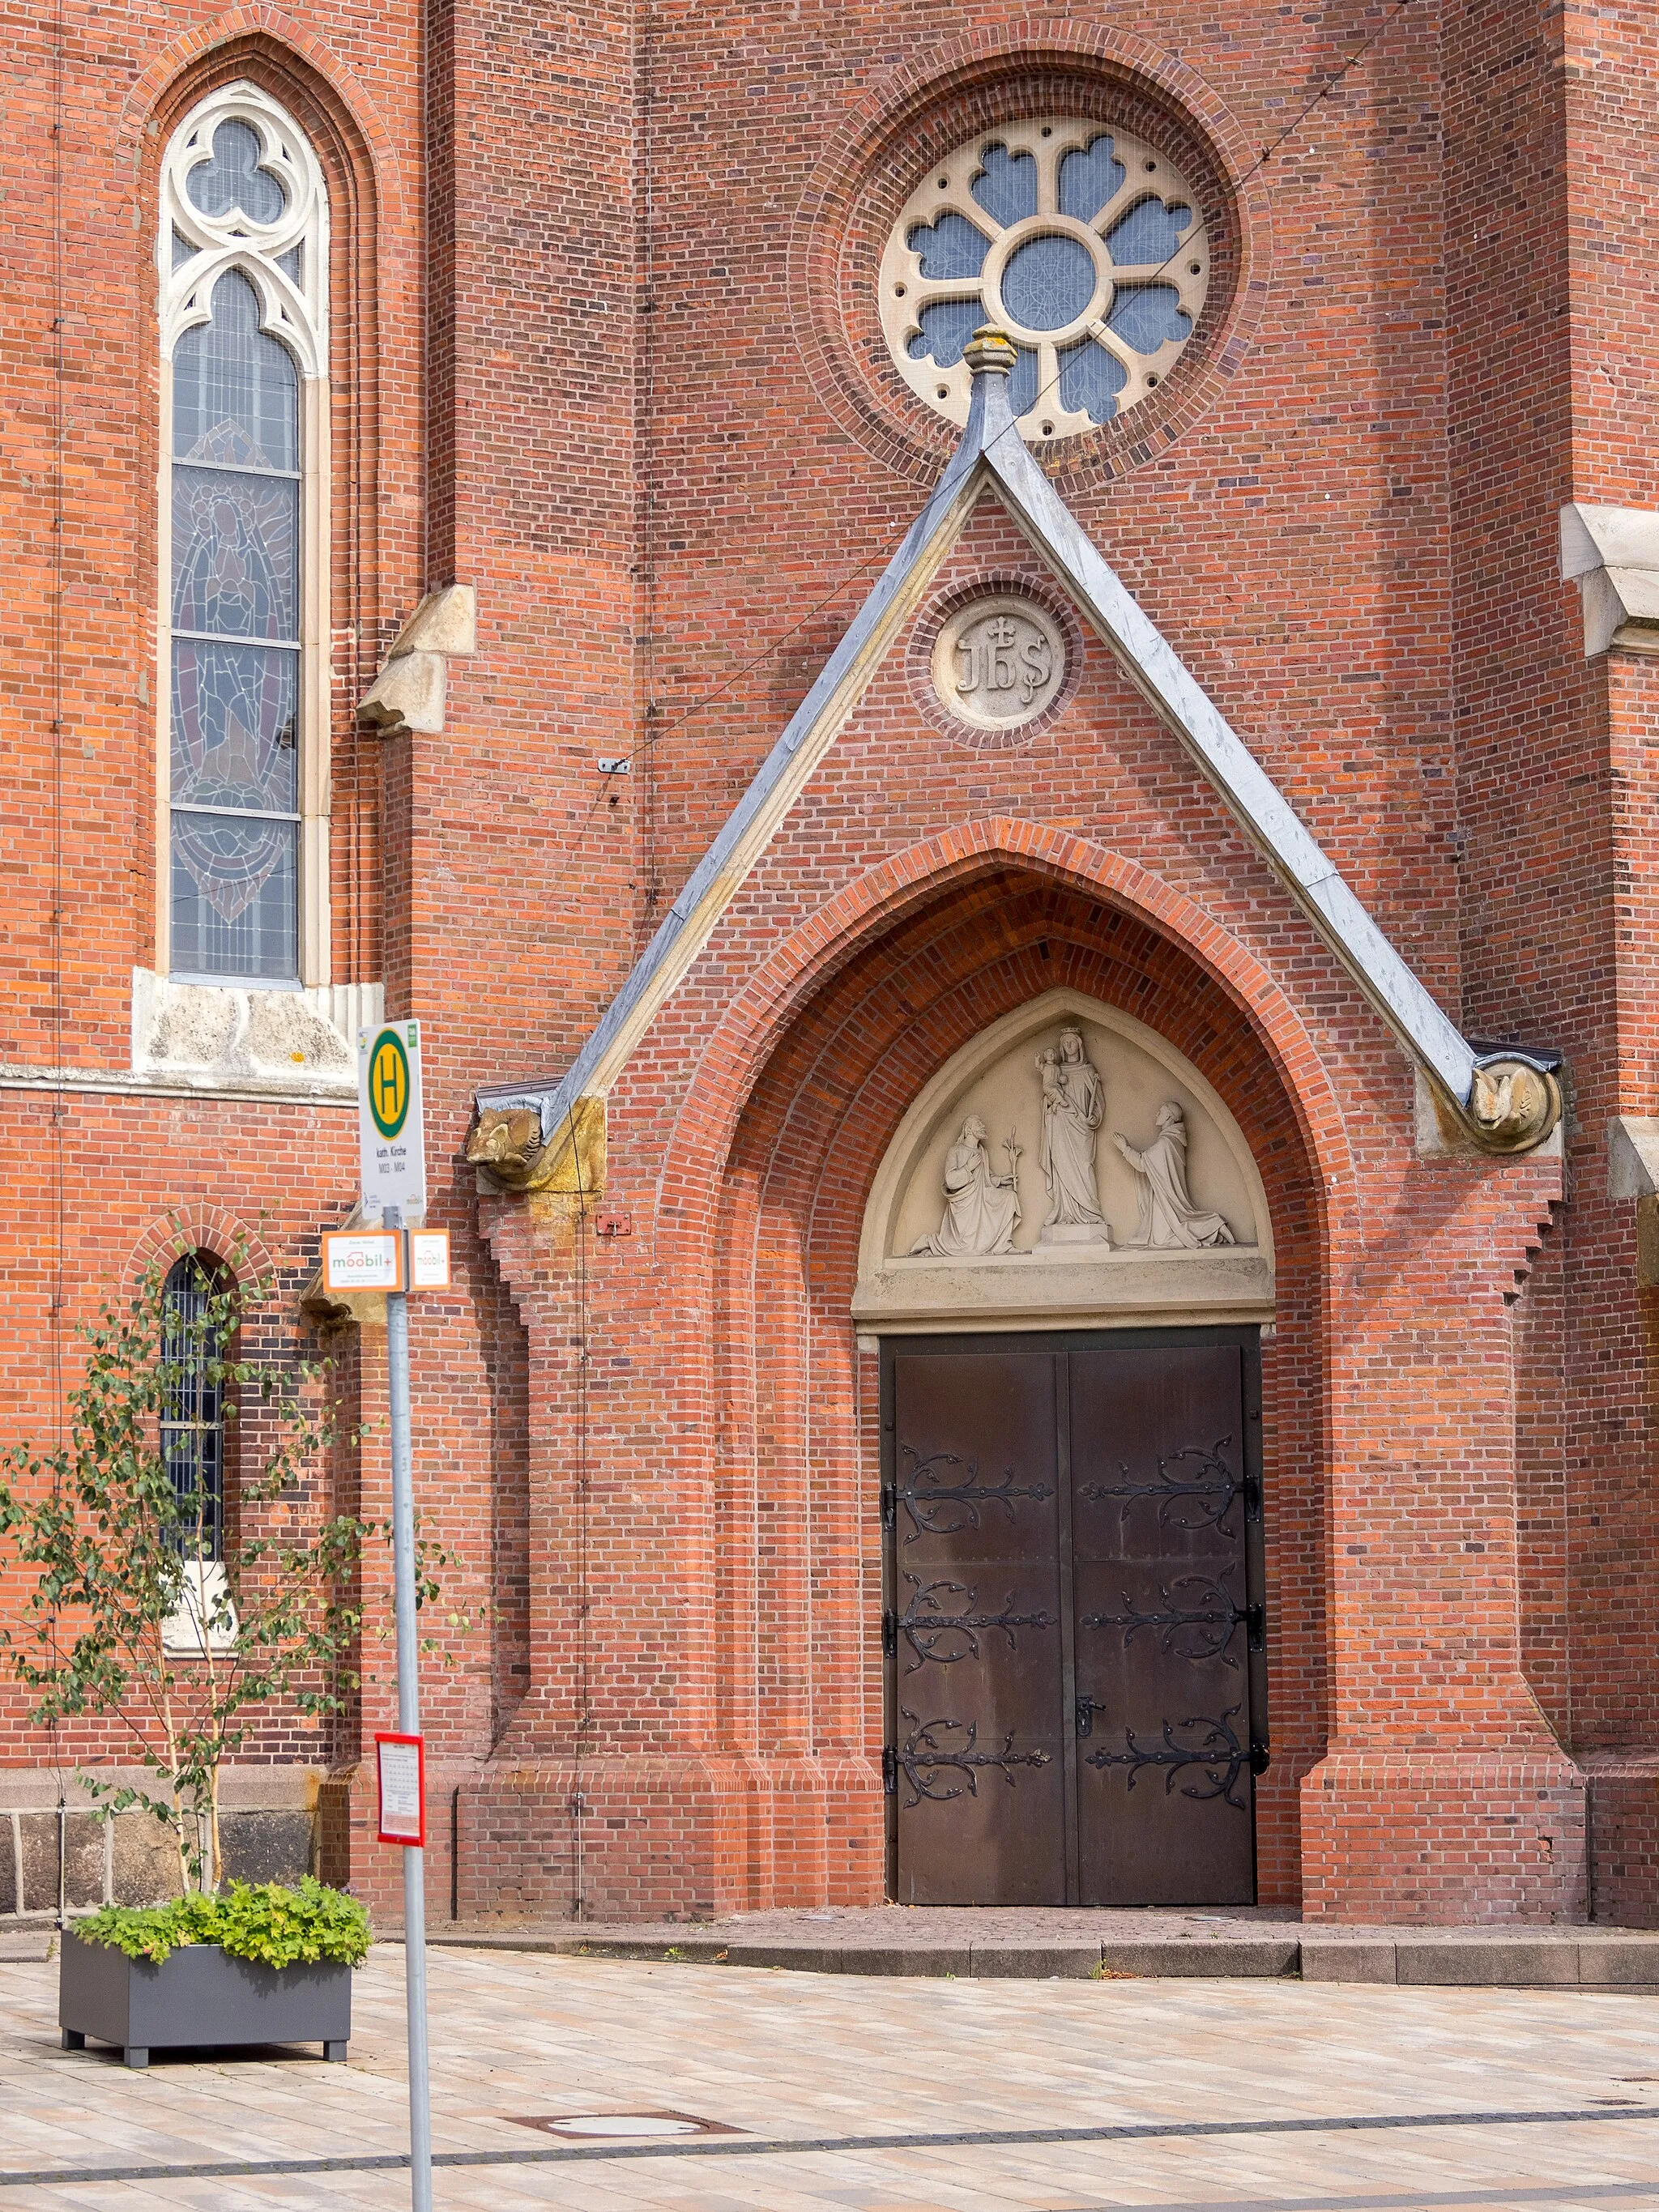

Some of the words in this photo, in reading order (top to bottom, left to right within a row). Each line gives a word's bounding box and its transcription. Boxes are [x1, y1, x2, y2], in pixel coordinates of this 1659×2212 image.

[380, 1053, 398, 1114] H
[377, 1147, 389, 1158] kath.
[390, 1144, 407, 1157] Kirche
[378, 1162, 390, 1174] M03
[394, 1161, 405, 1173] M04
[332, 1253, 392, 1268] moobil+
